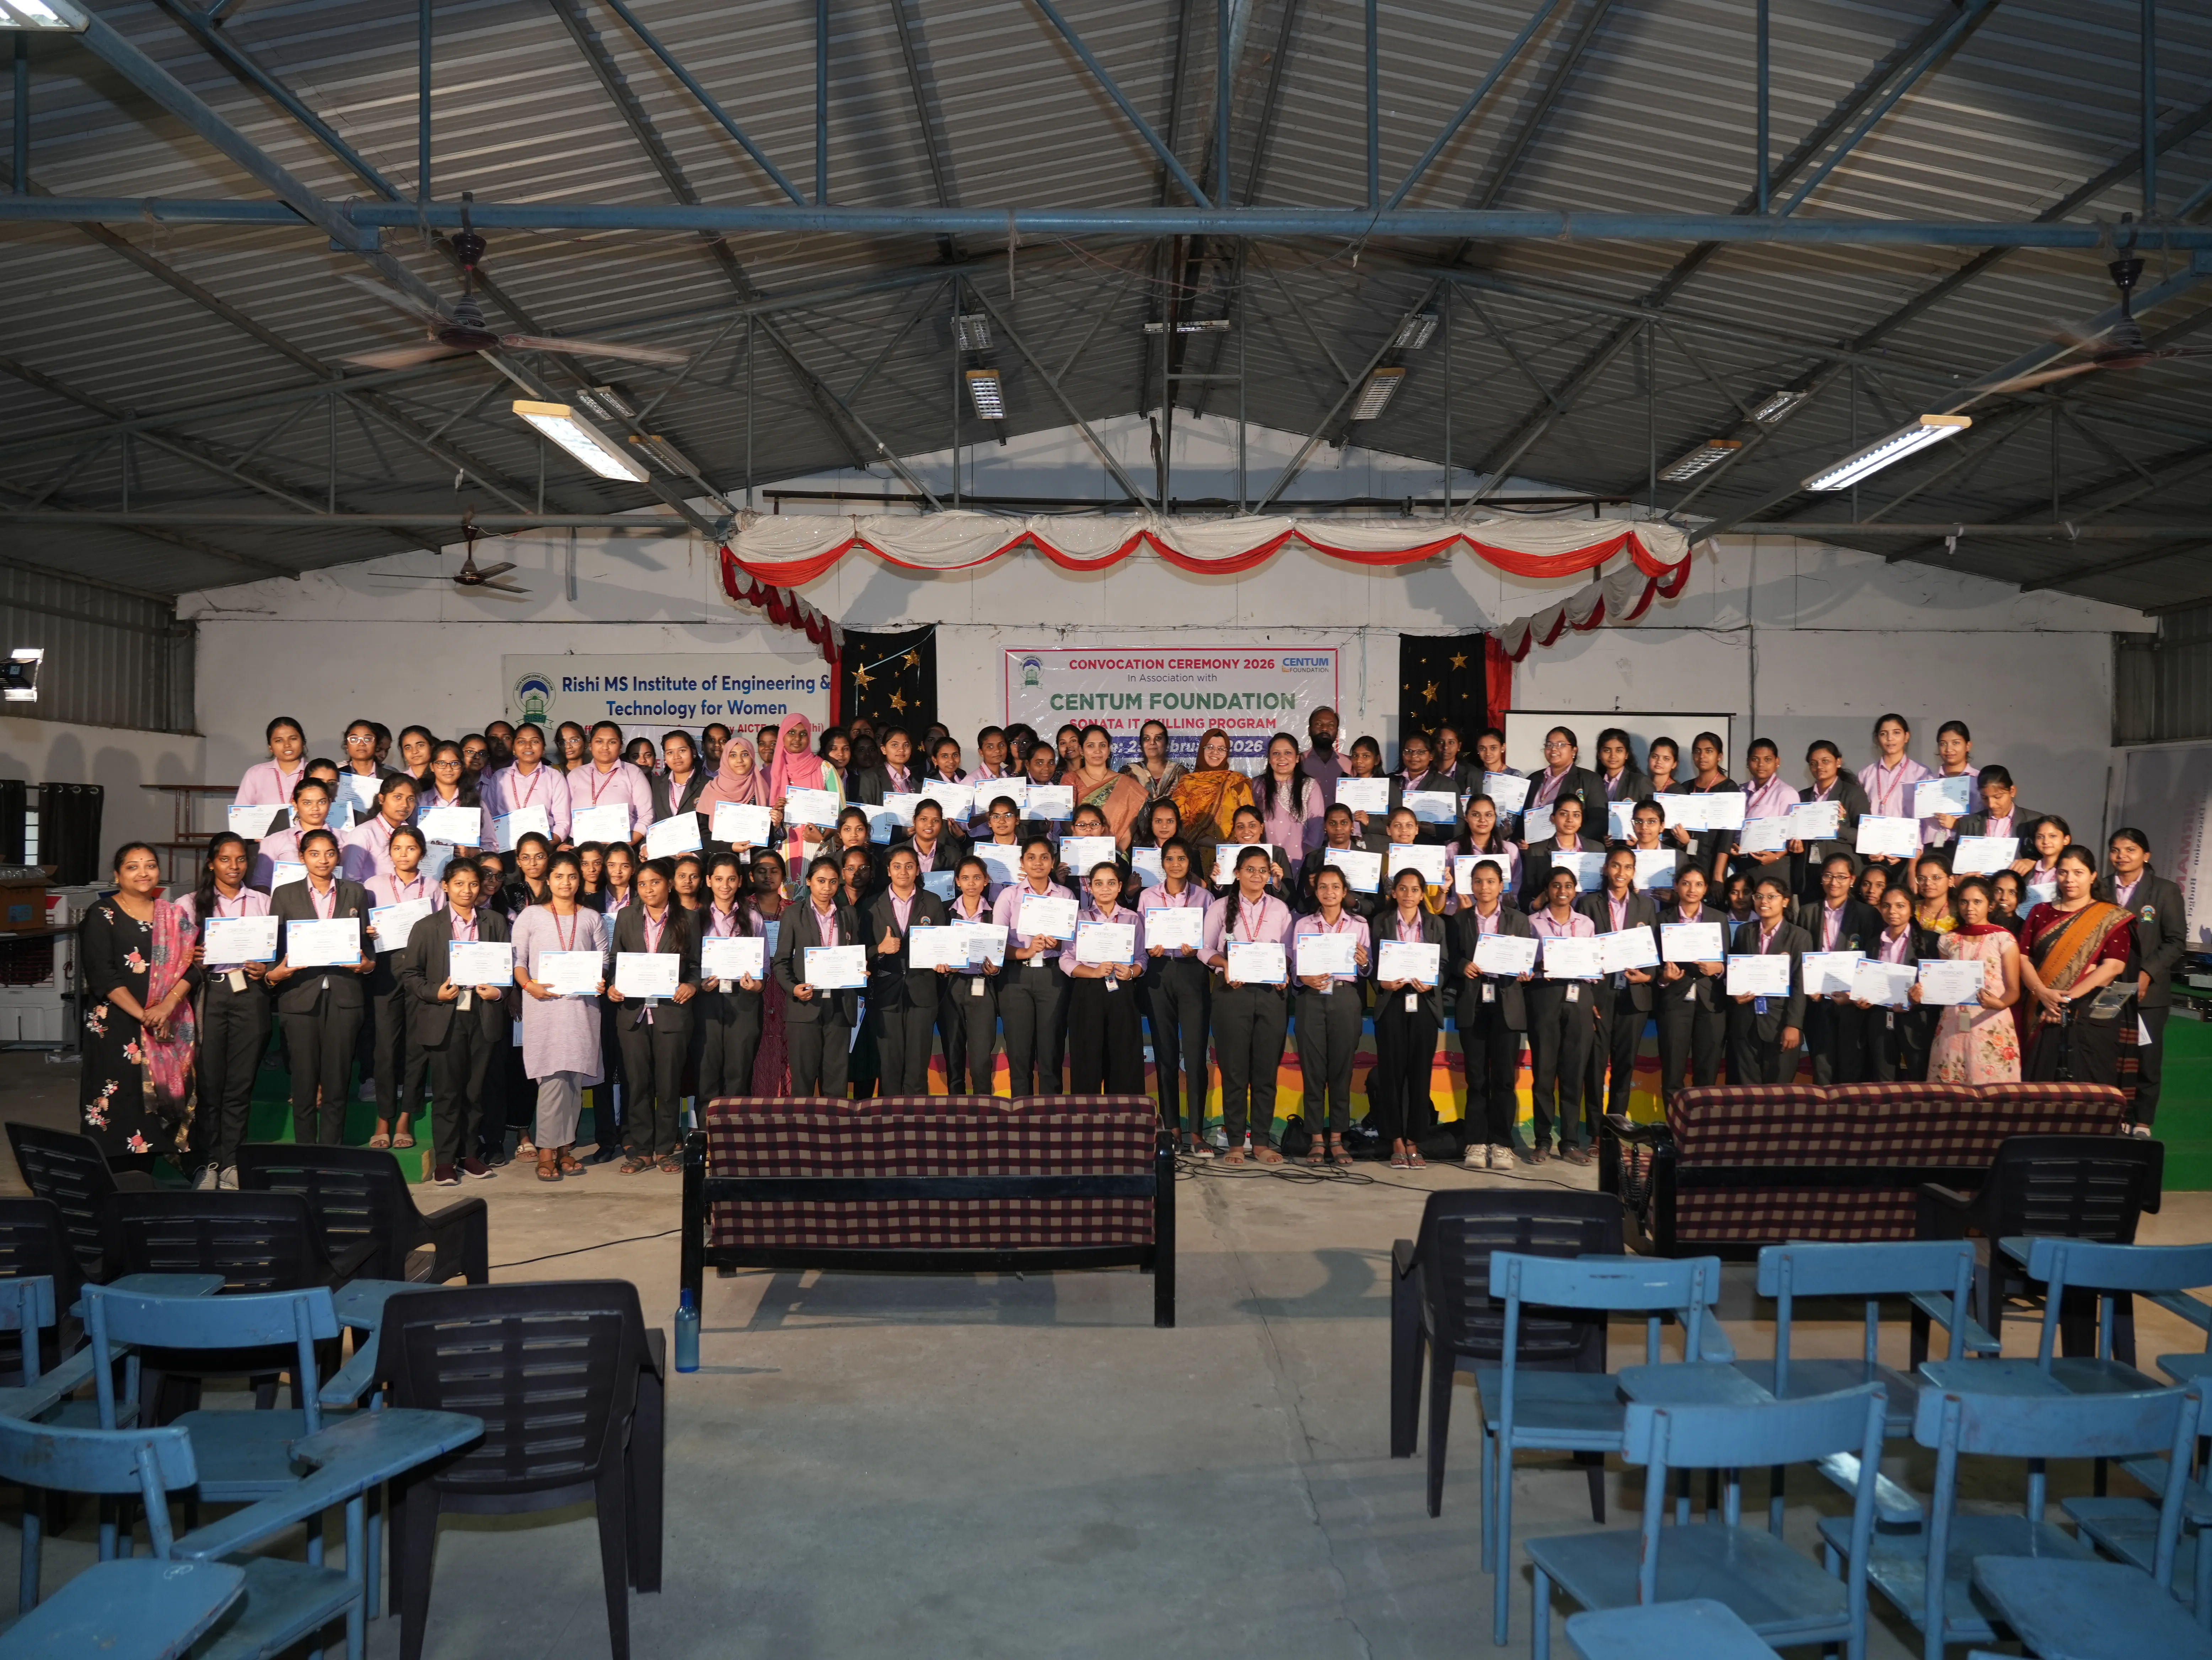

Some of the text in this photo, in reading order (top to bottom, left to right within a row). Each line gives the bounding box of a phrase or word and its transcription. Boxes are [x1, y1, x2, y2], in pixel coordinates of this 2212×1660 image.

[1069, 659, 1275, 670] CONVOCATION CEREMONY 2026
[1283, 658, 1328, 666] CENTUM
[1139, 673, 1194, 682] Association
[1197, 673, 1217, 681] with
[563, 675, 831, 694] Rishi MS Institute of Engineering &
[1050, 692, 1295, 711] CENTUM FOUNDATION
[606, 699, 787, 719] Technology for Women
[525, 715, 546, 723] RISHI
[1070, 718, 1276, 729] SONATA IT ILLING PROGRAM
[1126, 740, 1142, 753] 2
[1229, 740, 1263, 753] 2026
